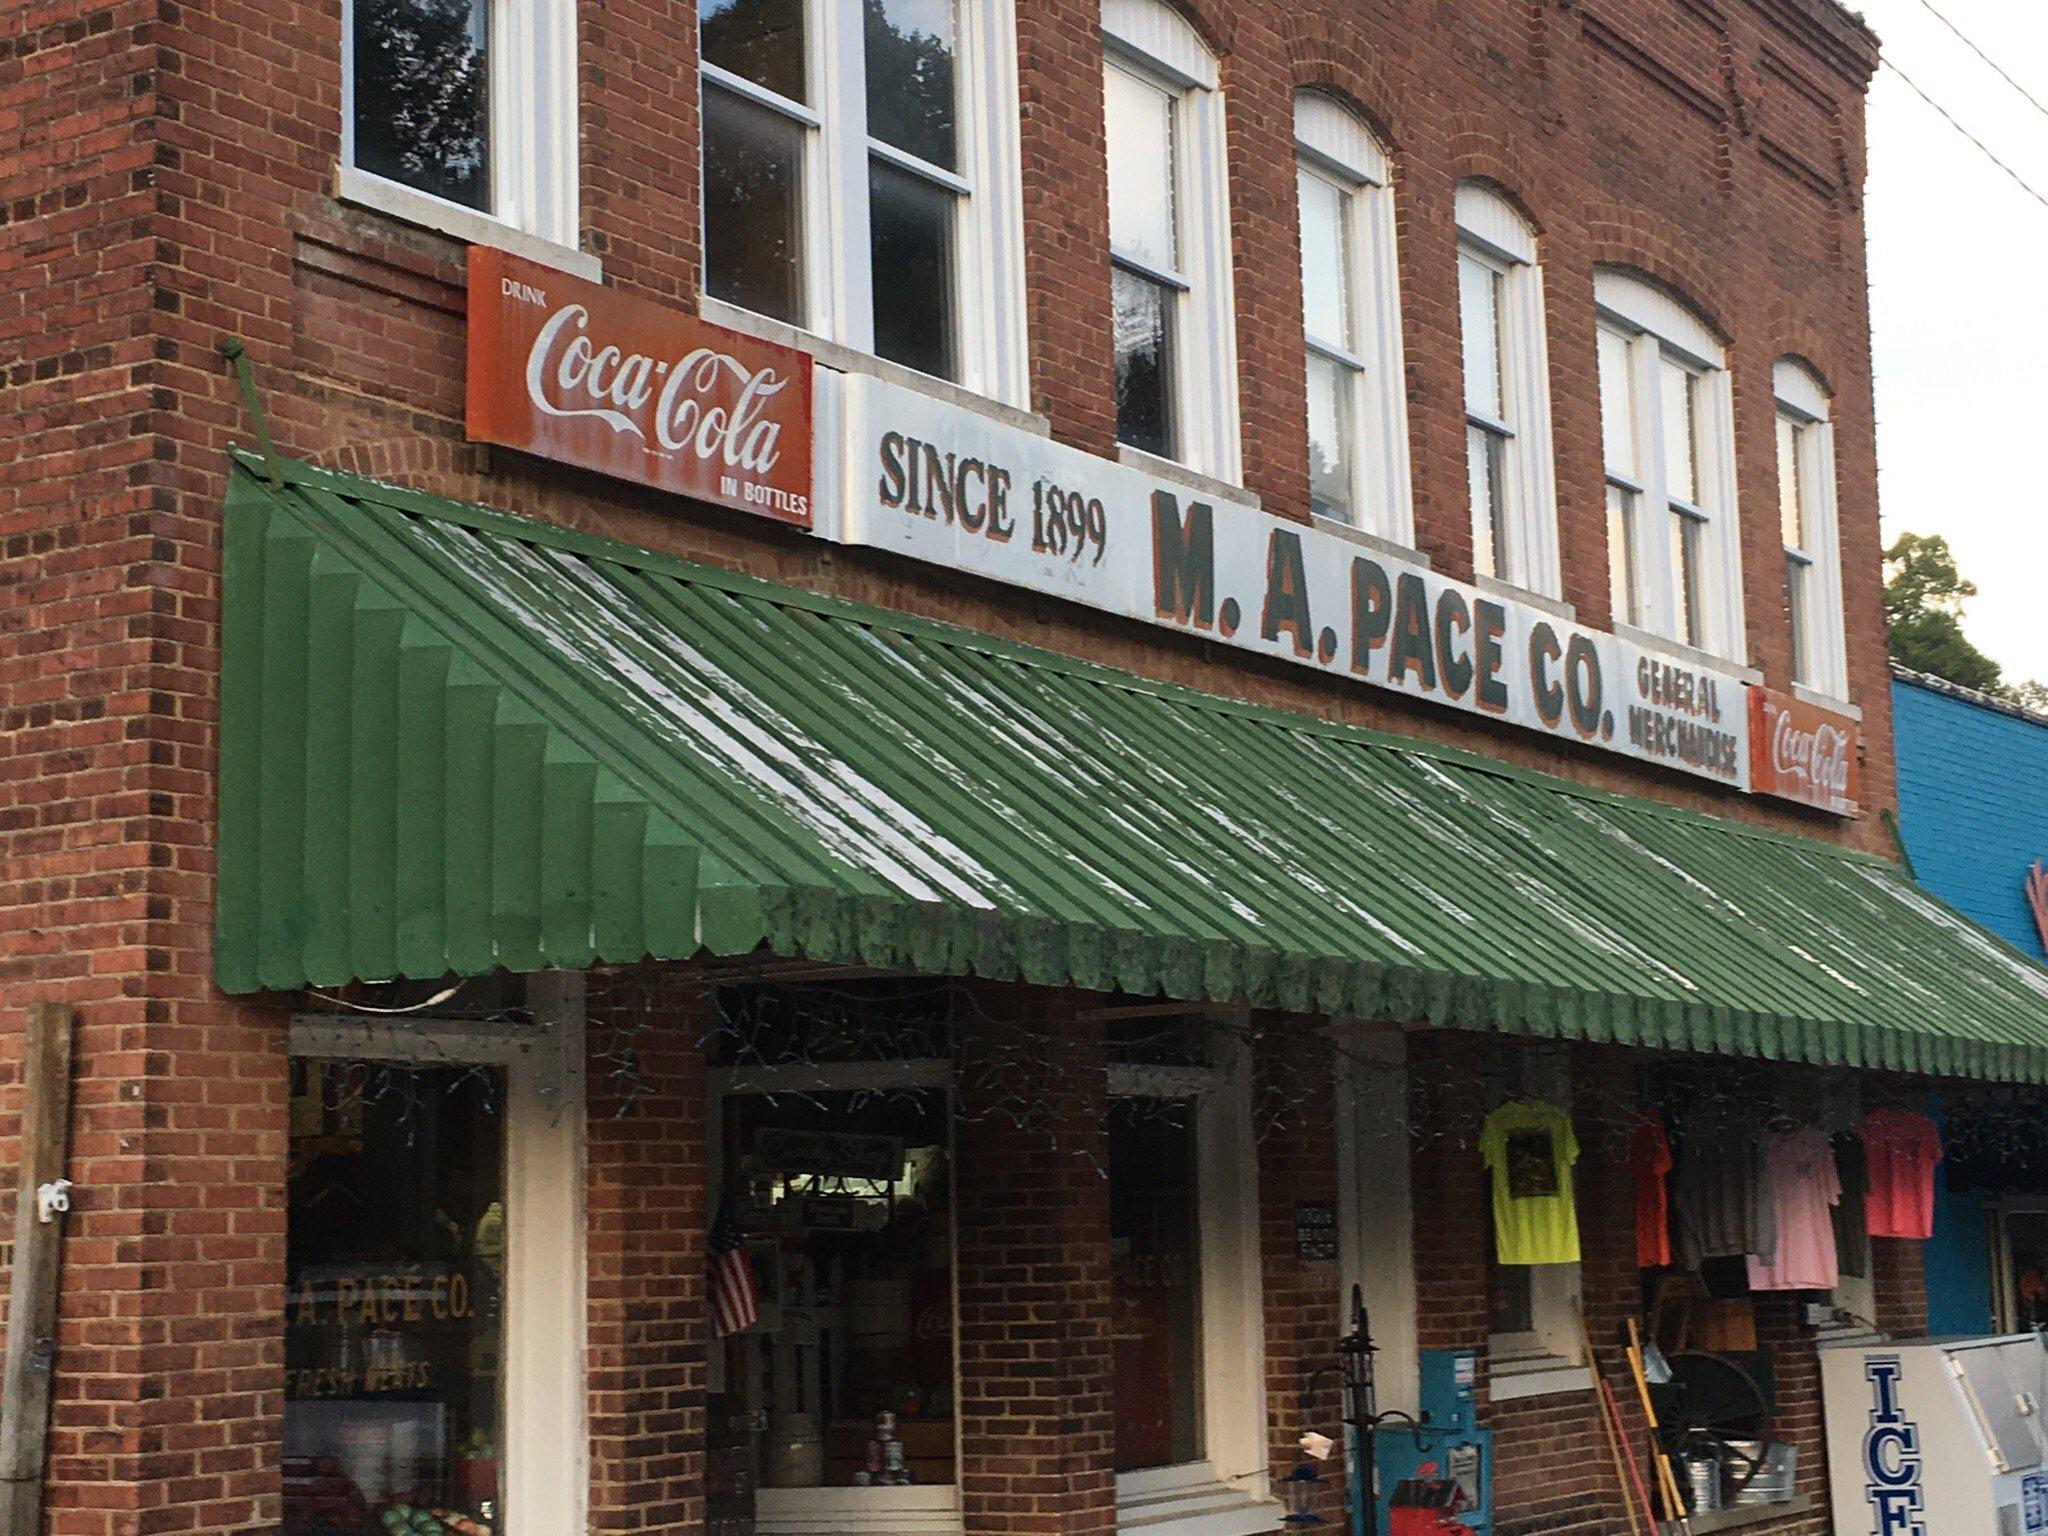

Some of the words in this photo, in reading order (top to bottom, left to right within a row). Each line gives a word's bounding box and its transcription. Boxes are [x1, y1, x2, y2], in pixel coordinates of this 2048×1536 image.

[502, 278, 547, 308] DRINK
[526, 303, 788, 474] Coca-Cola
[720, 475, 738, 497] IN
[743, 481, 808, 516] BOTTLES
[879, 430, 1015, 544] SINCE
[1031, 479, 1107, 568] 1899
[1151, 489, 1241, 639] M.
[1261, 527, 1338, 665] A.
[1350, 556, 1509, 714] PACE
[1529, 621, 1615, 742] CO.
[1637, 656, 1720, 724] GENERAL
[1629, 704, 1737, 779] MERCHANDISE
[1772, 709, 1850, 793] Coca-Cola
[337, 1274, 422, 1324] PACE
[430, 1273, 475, 1319] CO.
